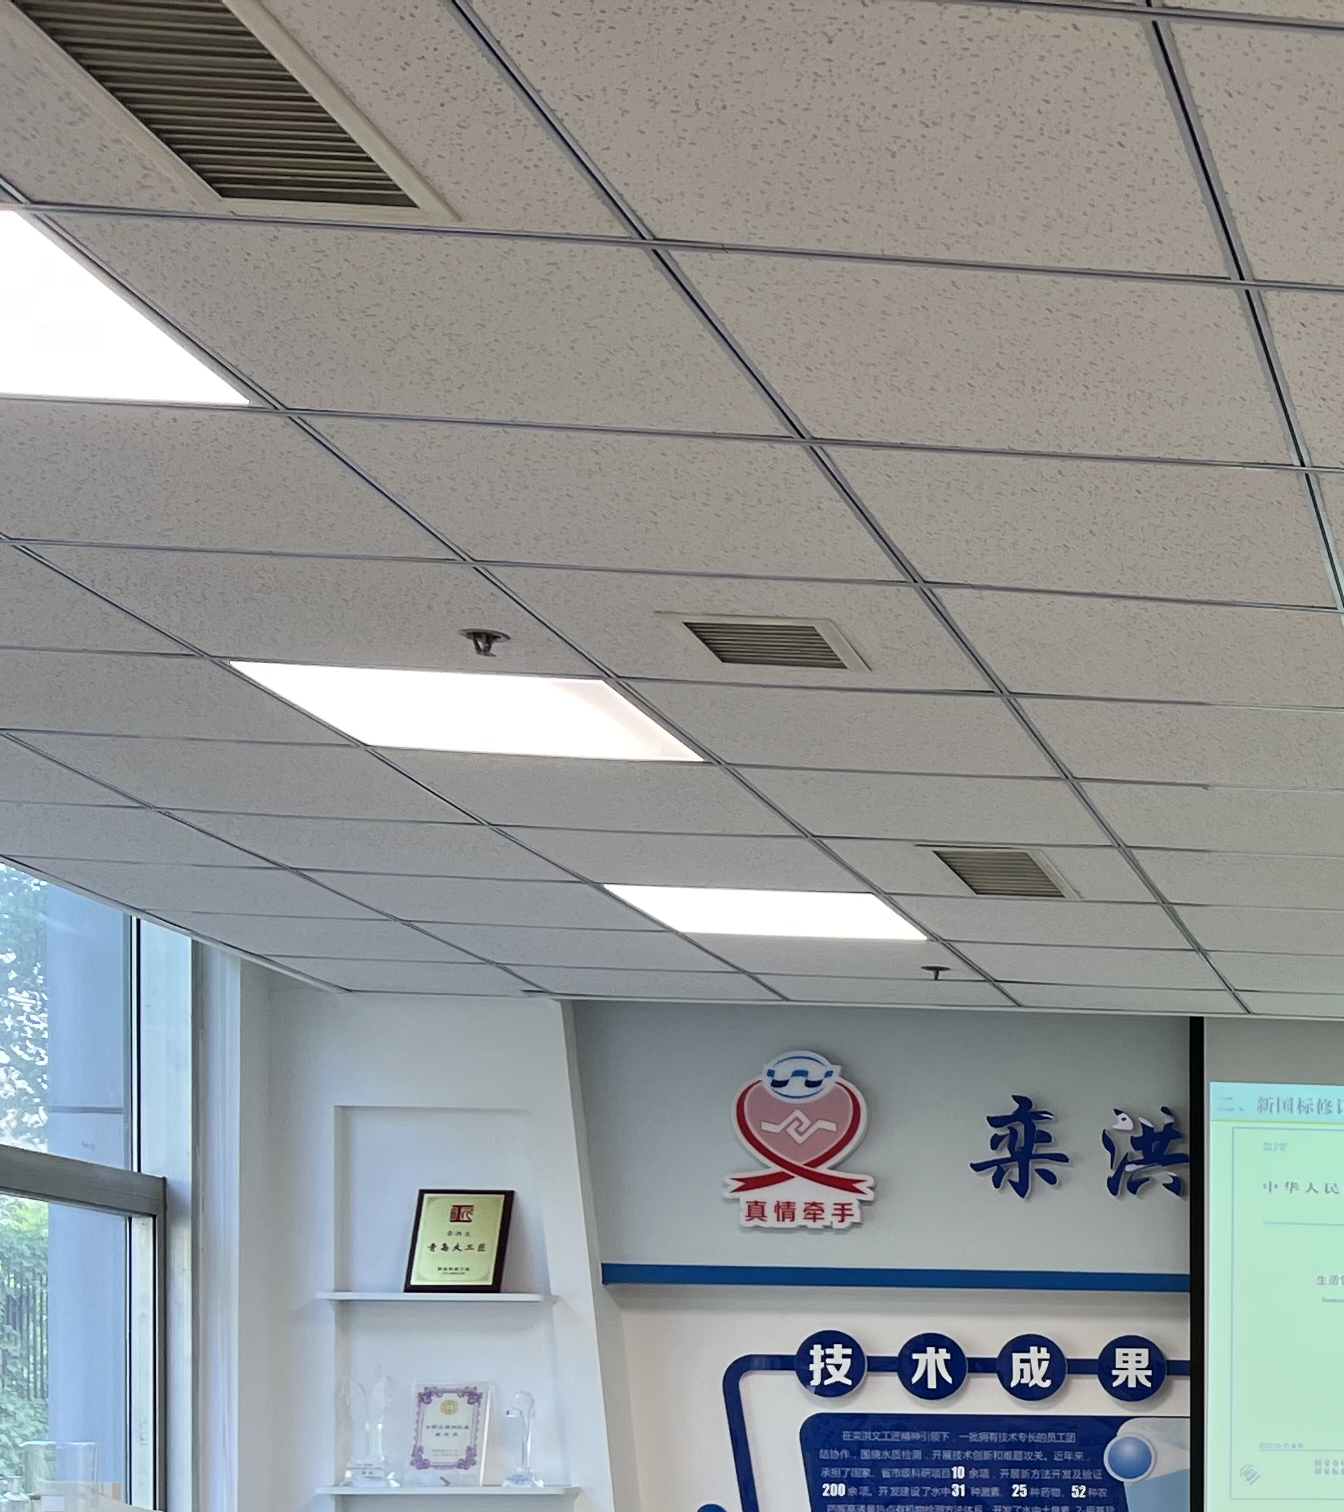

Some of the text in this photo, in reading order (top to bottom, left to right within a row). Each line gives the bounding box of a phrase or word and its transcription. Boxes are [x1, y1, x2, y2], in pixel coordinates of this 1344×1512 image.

[744, 1199, 855, 1223] 真情牵手
[808, 1343, 1153, 1389] 技术成果
